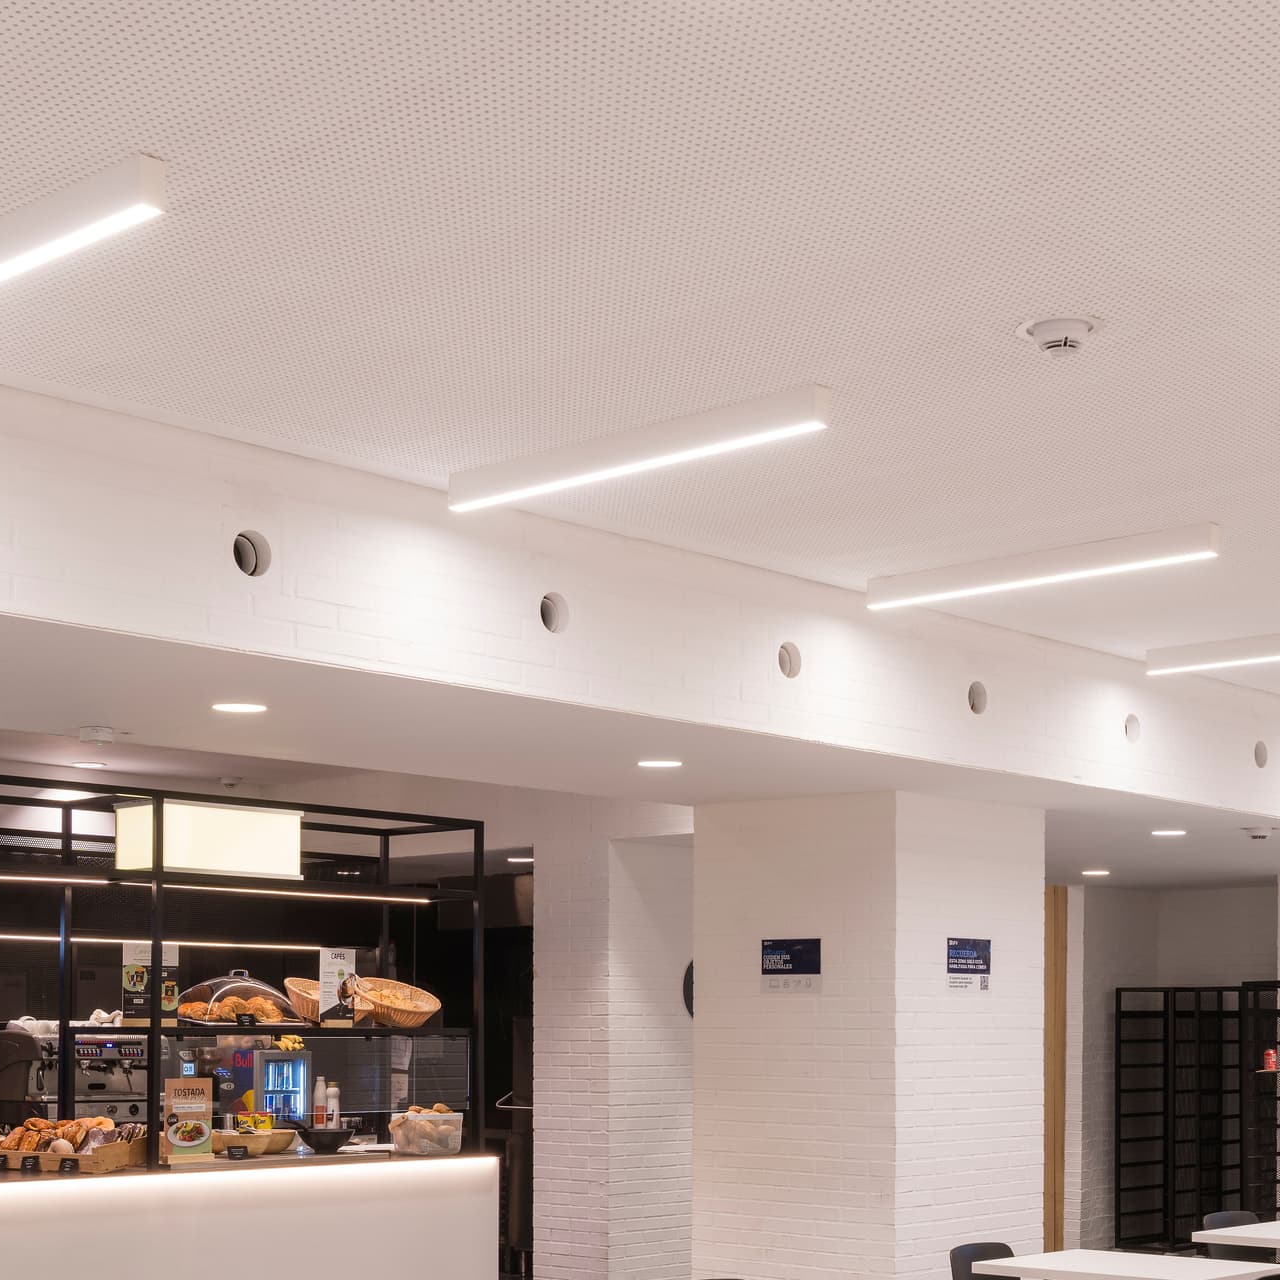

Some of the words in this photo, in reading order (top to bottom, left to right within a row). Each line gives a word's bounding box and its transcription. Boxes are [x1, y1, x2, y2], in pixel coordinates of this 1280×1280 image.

[330, 952, 345, 960] CAFÉS
[234, 1053, 253, 1068] Bull
[174, 1088, 205, 1097] TOSTADA
